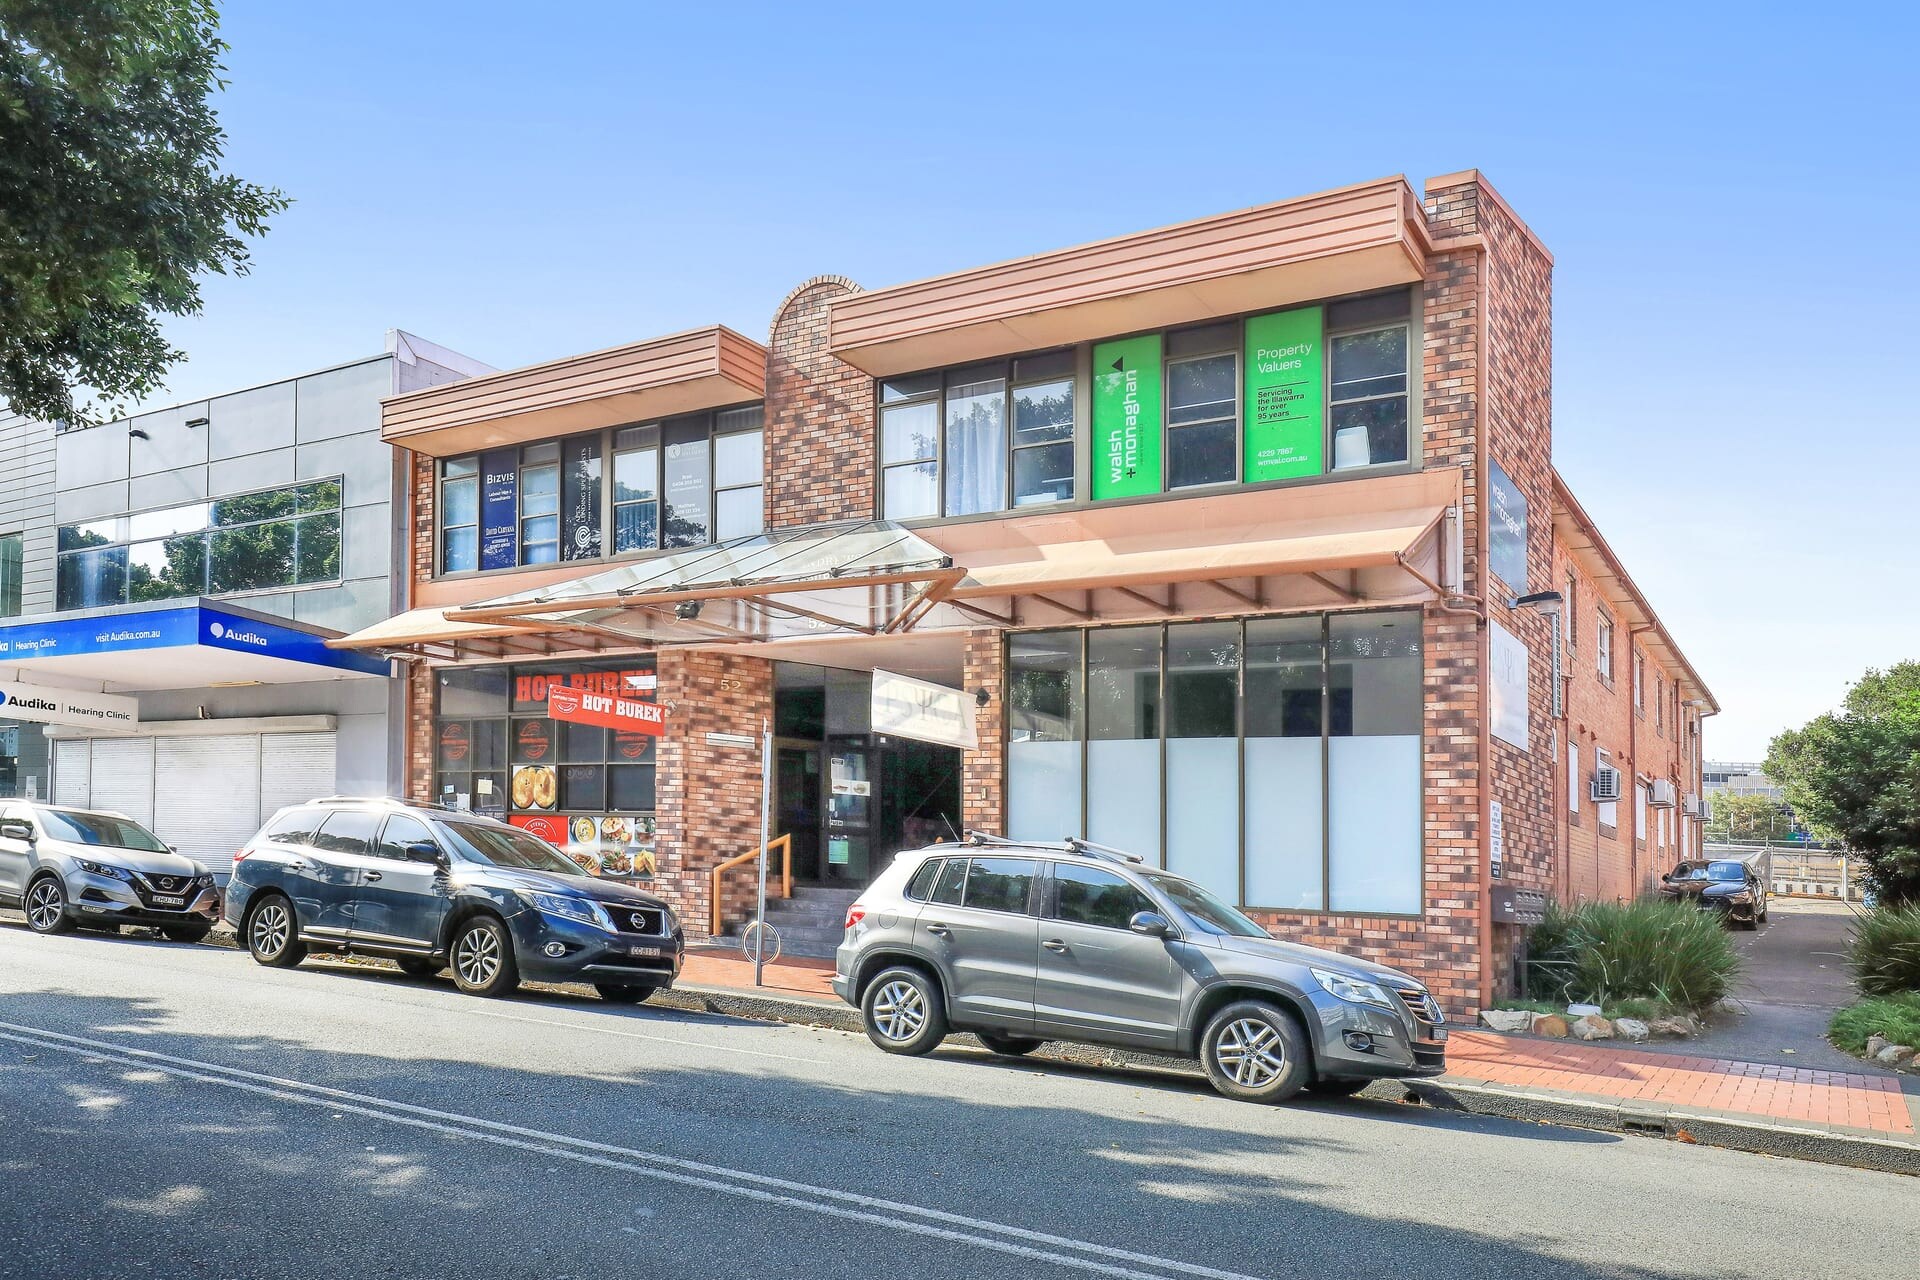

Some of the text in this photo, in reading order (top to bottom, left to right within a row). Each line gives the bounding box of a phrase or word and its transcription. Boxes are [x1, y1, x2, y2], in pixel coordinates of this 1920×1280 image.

[1257, 343, 1313, 361] Property
[1257, 359, 1302, 374] Valuers
[1257, 388, 1293, 399] Servicing
[1257, 398, 1270, 406] the
[1257, 402, 1288, 413] for over
[1257, 410, 1290, 420] 95 years
[1108, 429, 1123, 483] walsh
[95, 630, 161, 643] visit Audika.com.au
[225, 628, 268, 647] Audika
[15, 640, 39, 651] Hearing
[39, 637, 57, 648] Clinic
[7, 695, 131, 721] Audika Hearing Clinic
[582, 693, 613, 714] HOT
[615, 699, 662, 723] BUREK
